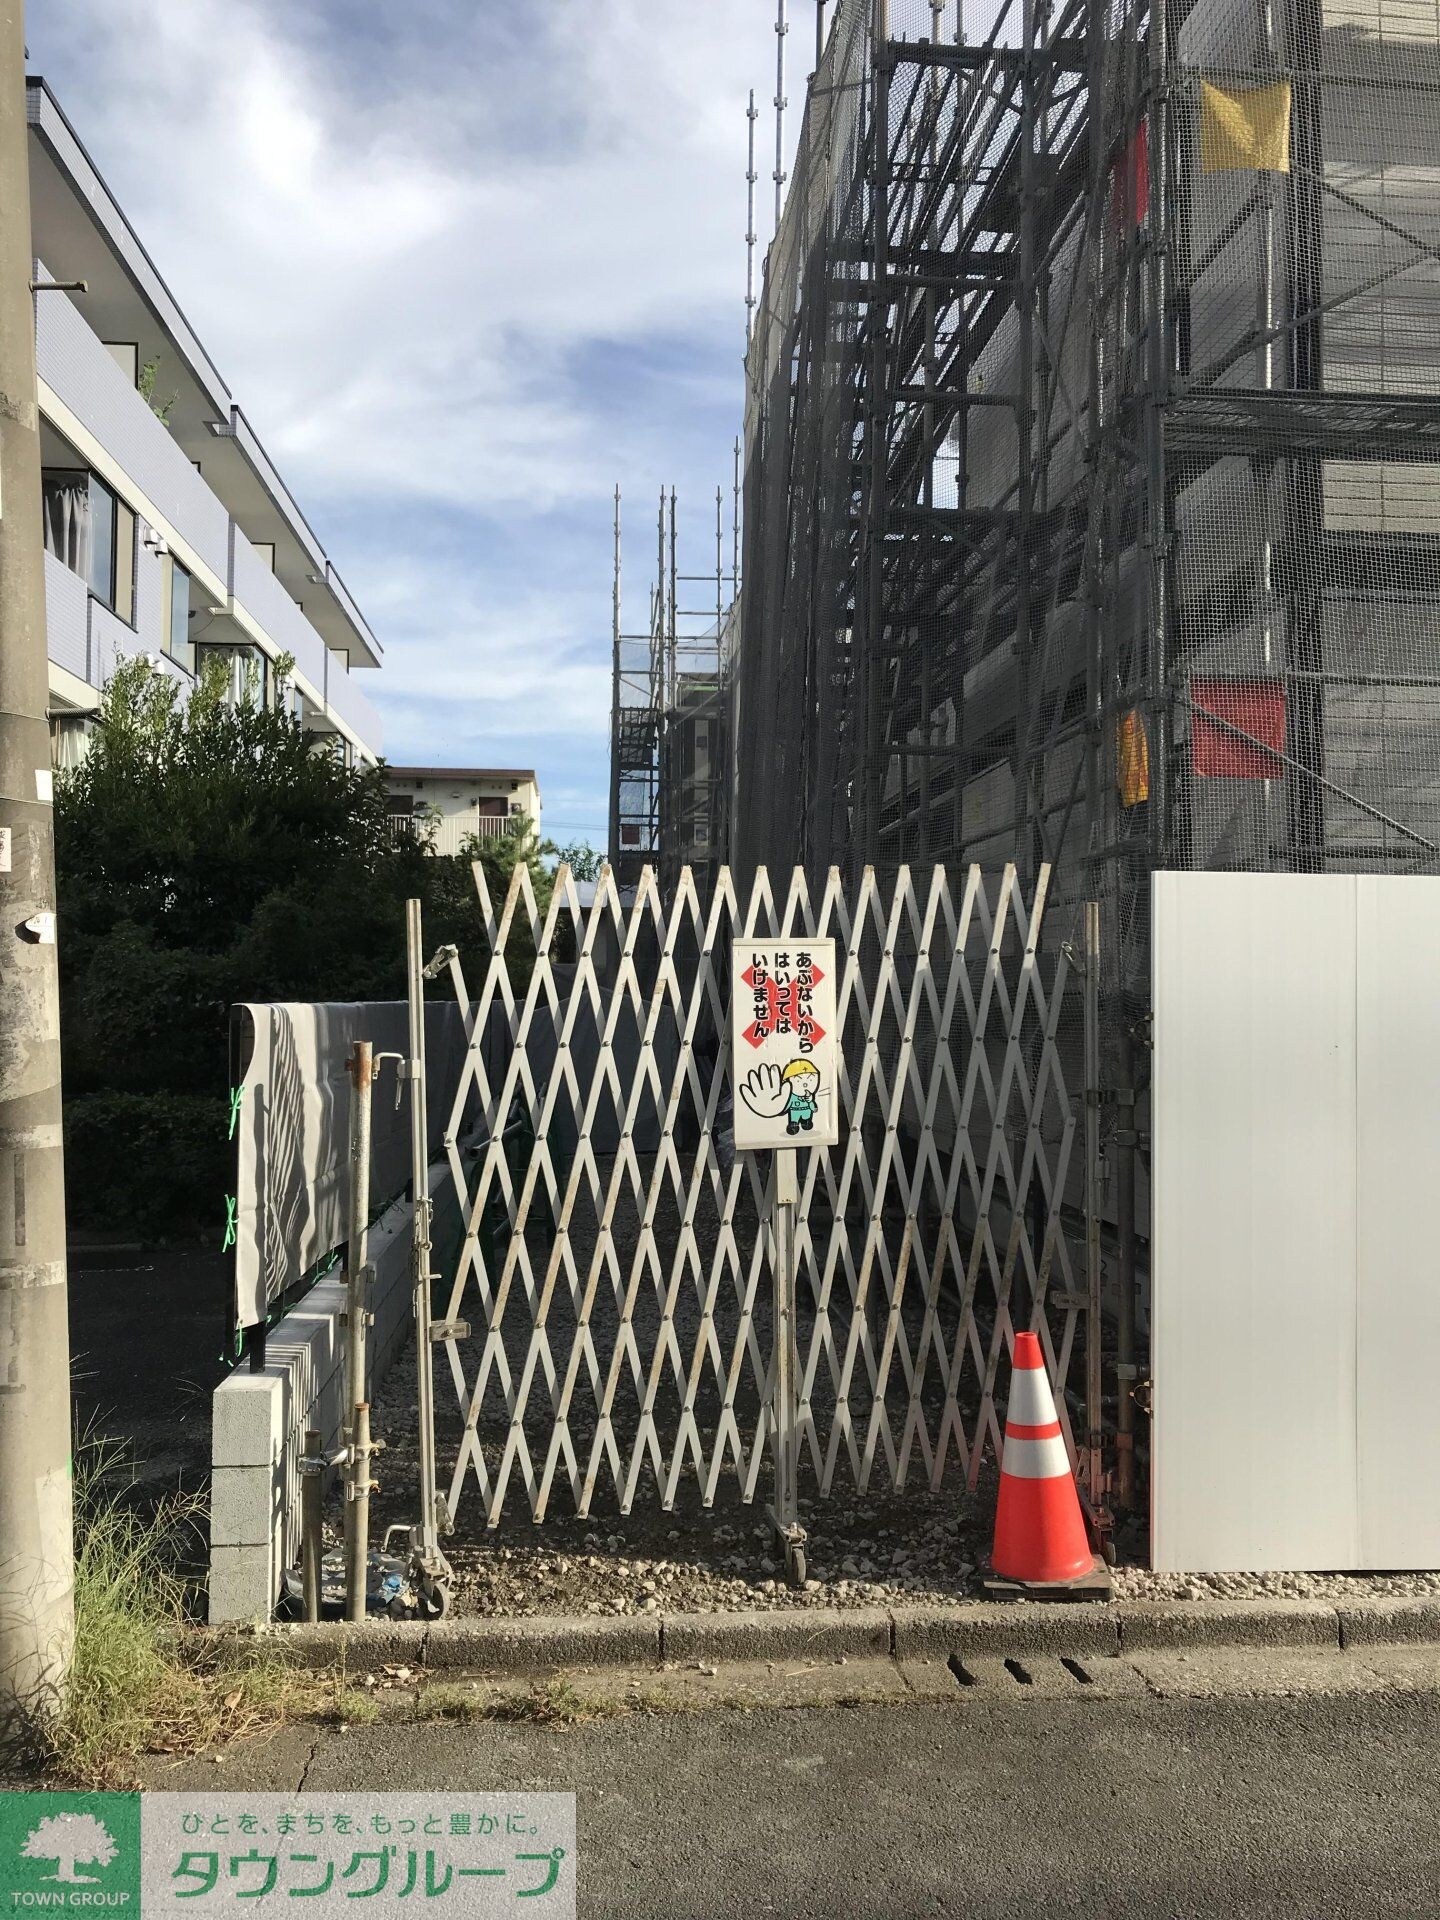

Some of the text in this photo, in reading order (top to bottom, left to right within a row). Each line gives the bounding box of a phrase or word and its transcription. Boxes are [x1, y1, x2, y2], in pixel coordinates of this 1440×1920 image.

[752, 953, 770, 1038] いけません
[774, 952, 792, 1035] はいっては
[796, 951, 814, 1054] あぶないから
